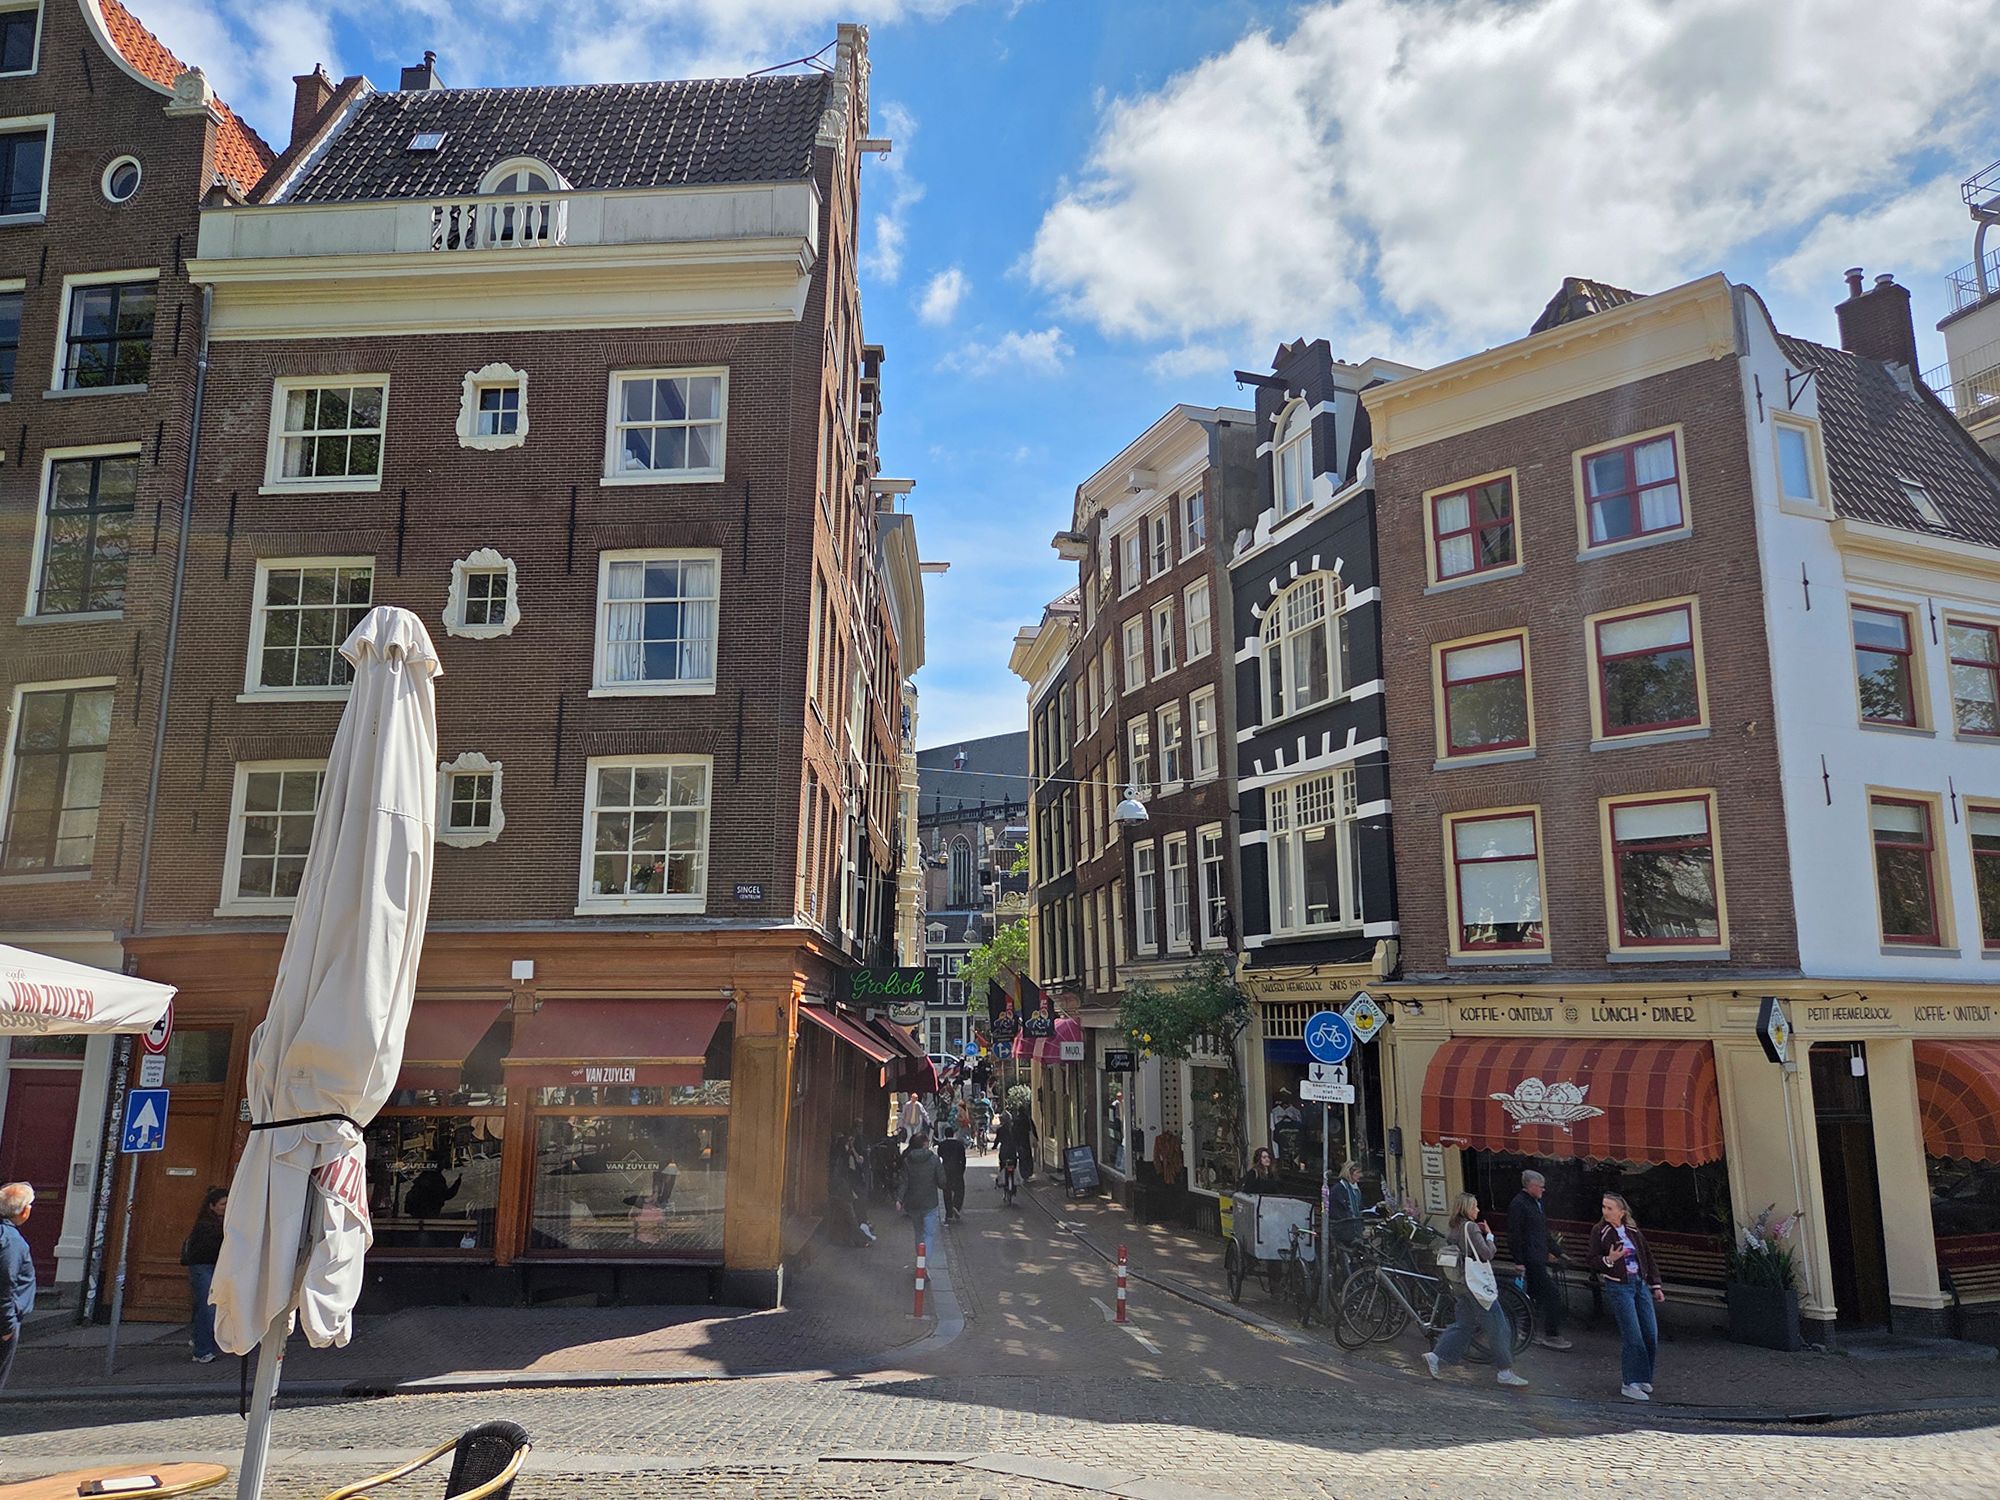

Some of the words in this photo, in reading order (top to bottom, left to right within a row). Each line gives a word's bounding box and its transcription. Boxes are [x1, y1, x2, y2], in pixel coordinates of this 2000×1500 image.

[737, 885, 761, 894] SINGEL
[850, 969, 925, 999] Grolsch
[8, 981, 41, 1013] VAN
[40, 984, 94, 1020] ZUYLEN
[892, 1007, 920, 1018] Grolsch
[1460, 1007, 1499, 1021] KOFFIE
[1591, 1007, 1639, 1022] LUNCH
[1652, 1007, 1697, 1022] DINER
[1807, 1007, 1830, 1021] PETIT
[1914, 1006, 1946, 1021] KOFFIE
[585, 1067, 603, 1082] VAN
[603, 1067, 636, 1082] ZUYLEN
